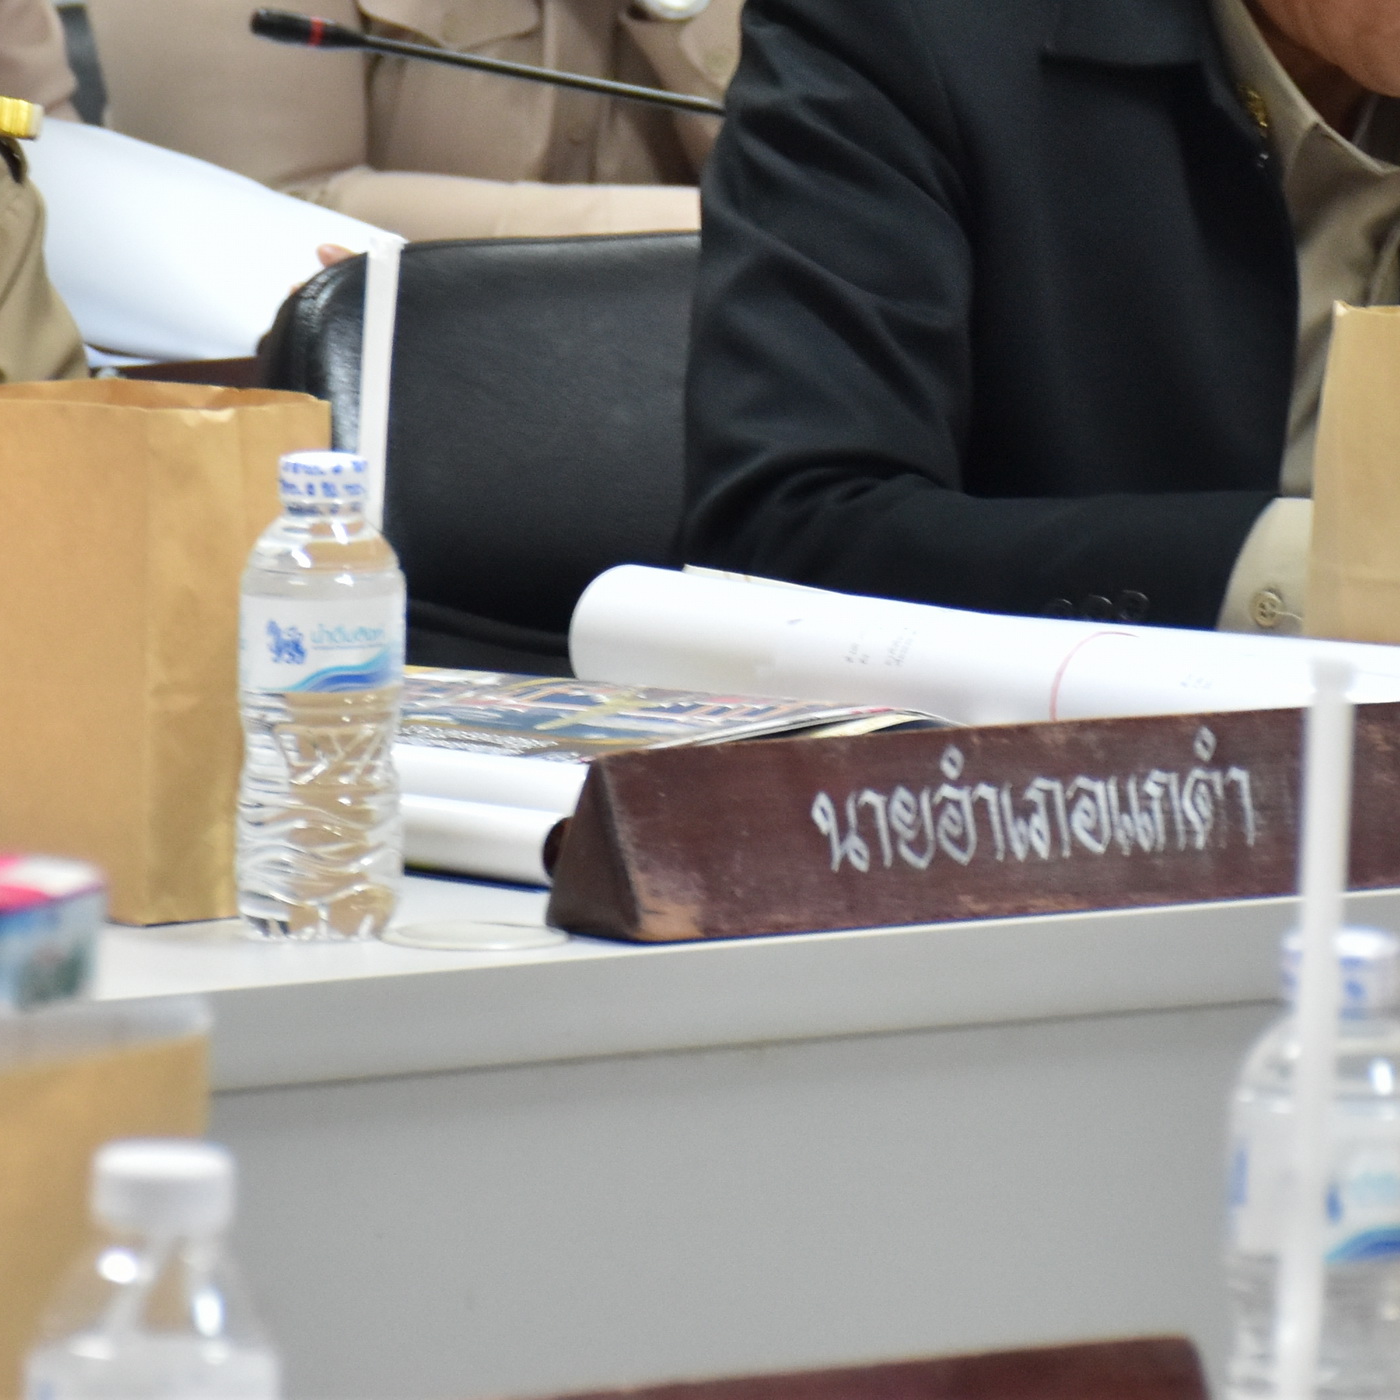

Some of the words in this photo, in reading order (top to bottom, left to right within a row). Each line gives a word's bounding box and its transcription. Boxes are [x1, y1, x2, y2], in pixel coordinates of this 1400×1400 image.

[811, 726, 1256, 873] นายอำเภอแกดำ
